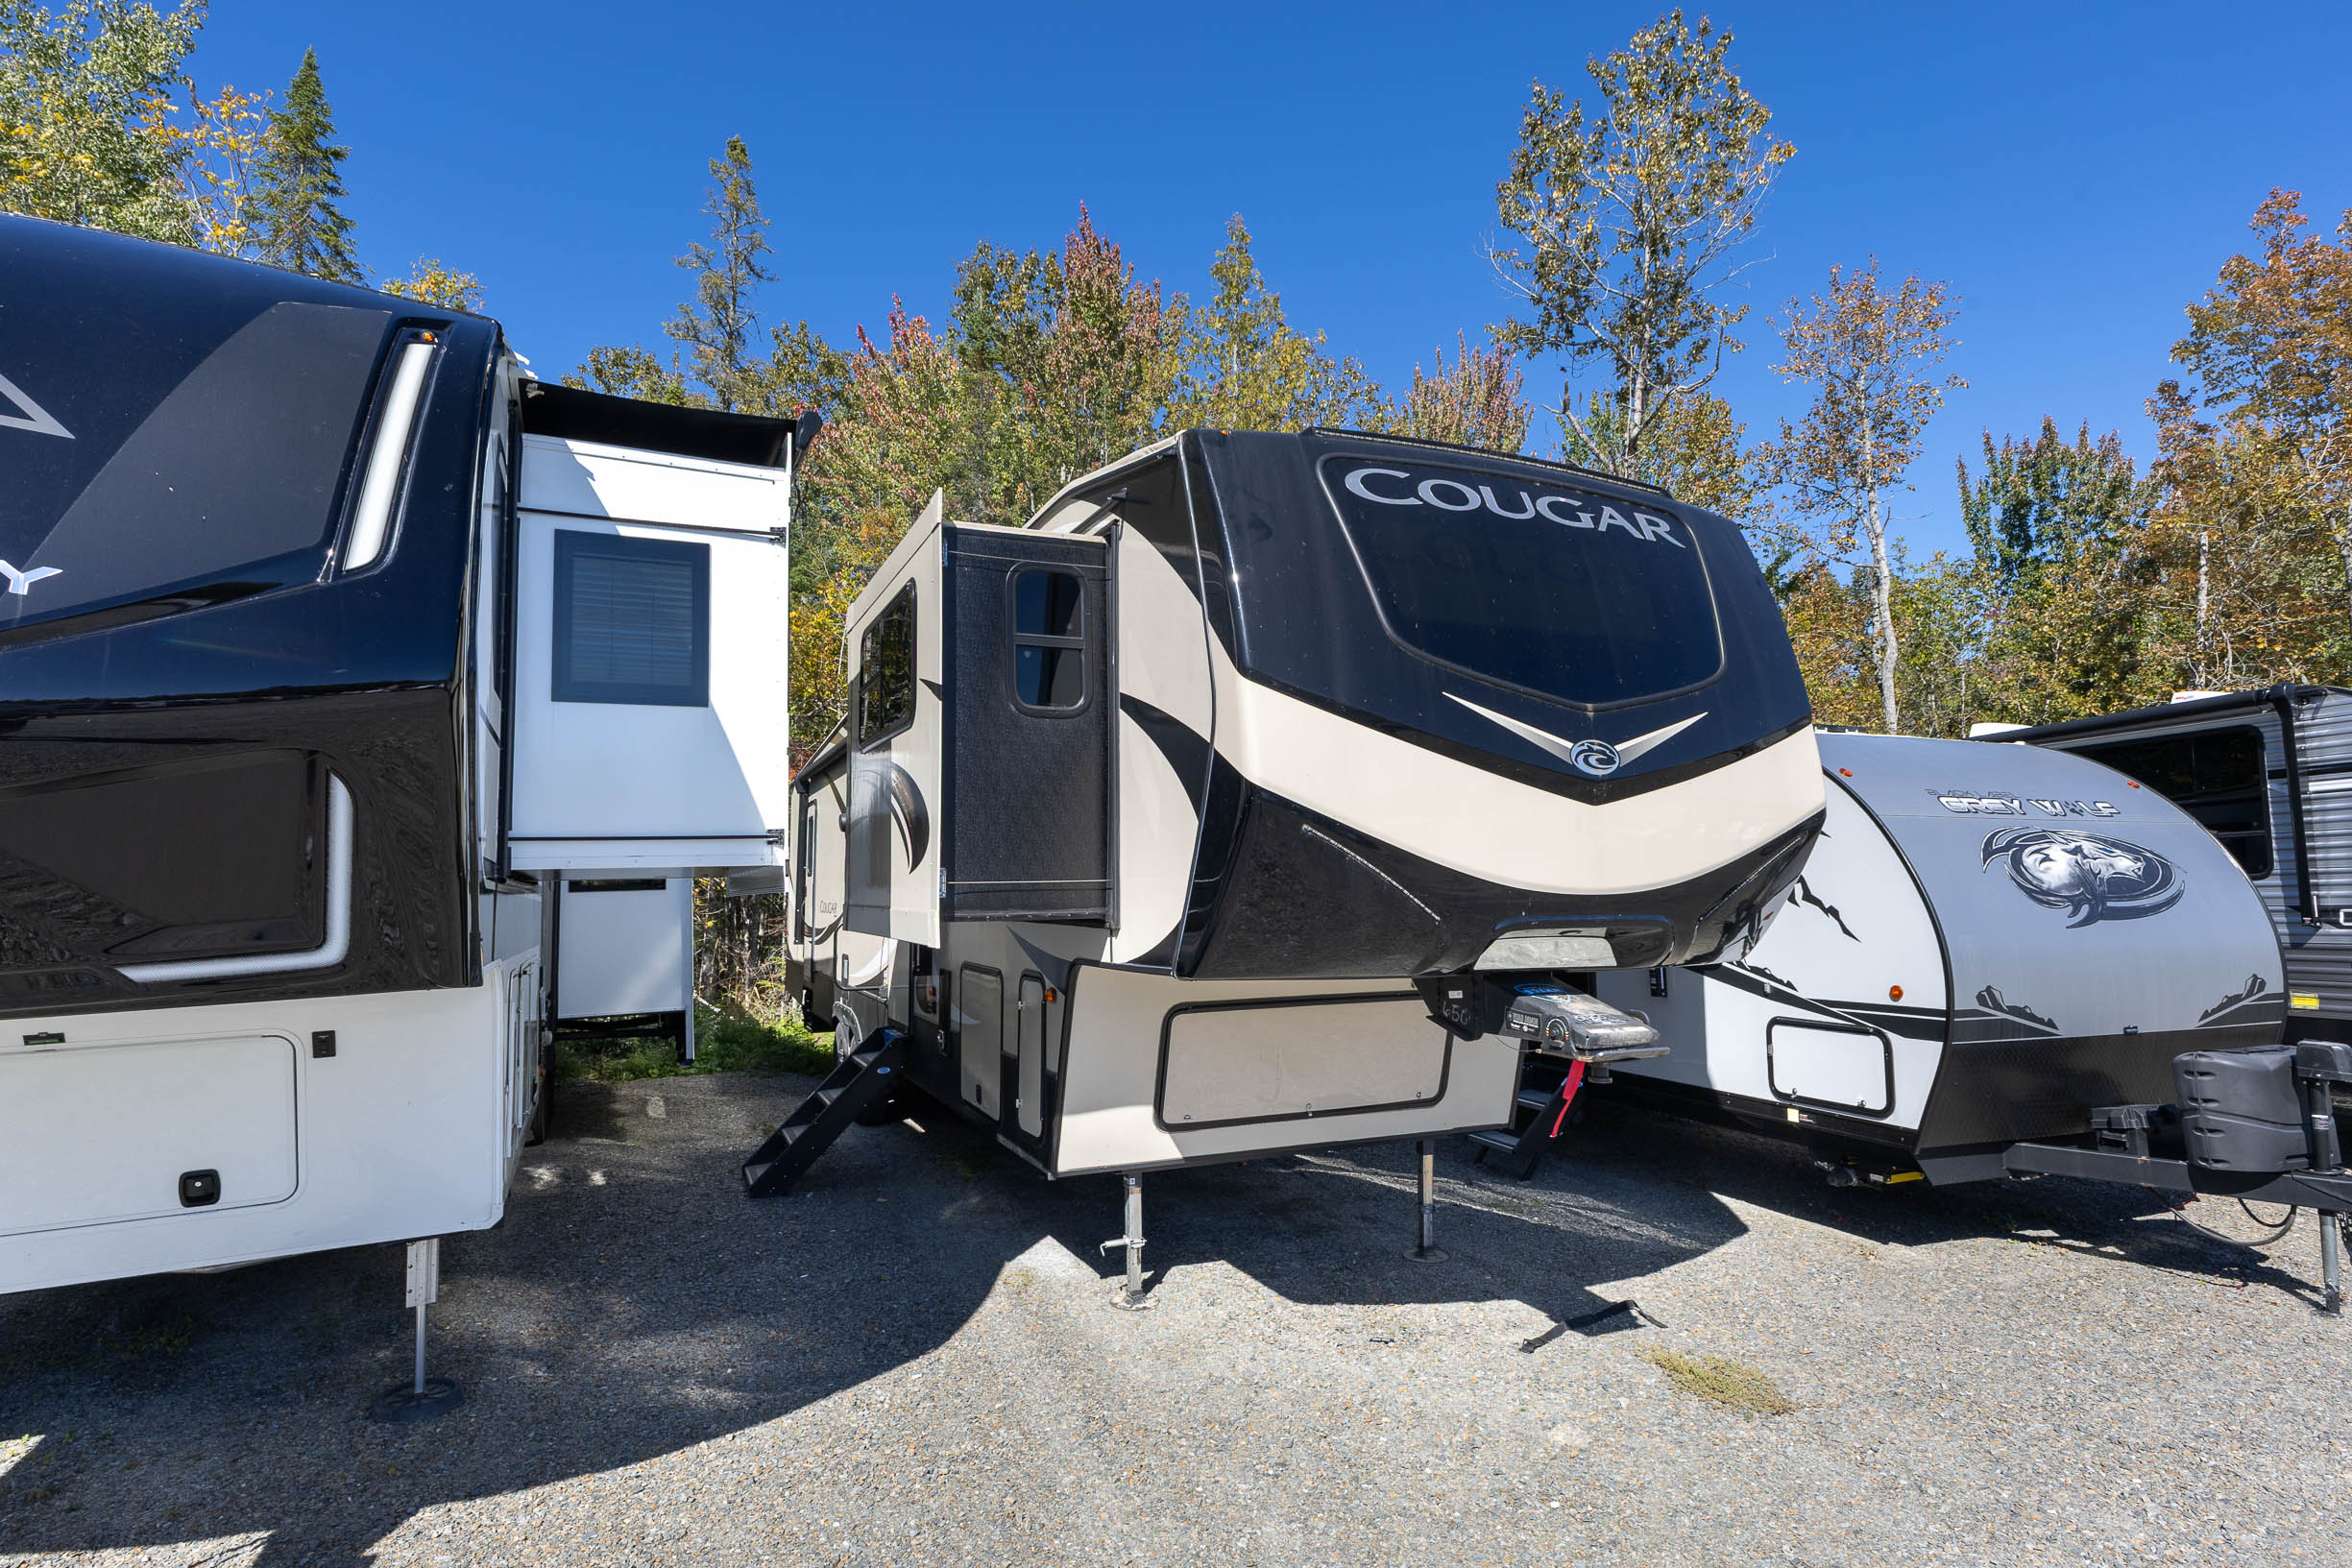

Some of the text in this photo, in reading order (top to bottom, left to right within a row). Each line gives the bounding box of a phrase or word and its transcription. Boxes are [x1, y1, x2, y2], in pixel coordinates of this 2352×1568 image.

[1345, 468, 1686, 548] COUGAR
[1937, 796, 2026, 815] GREY
[820, 900, 837, 914] COUGAR
